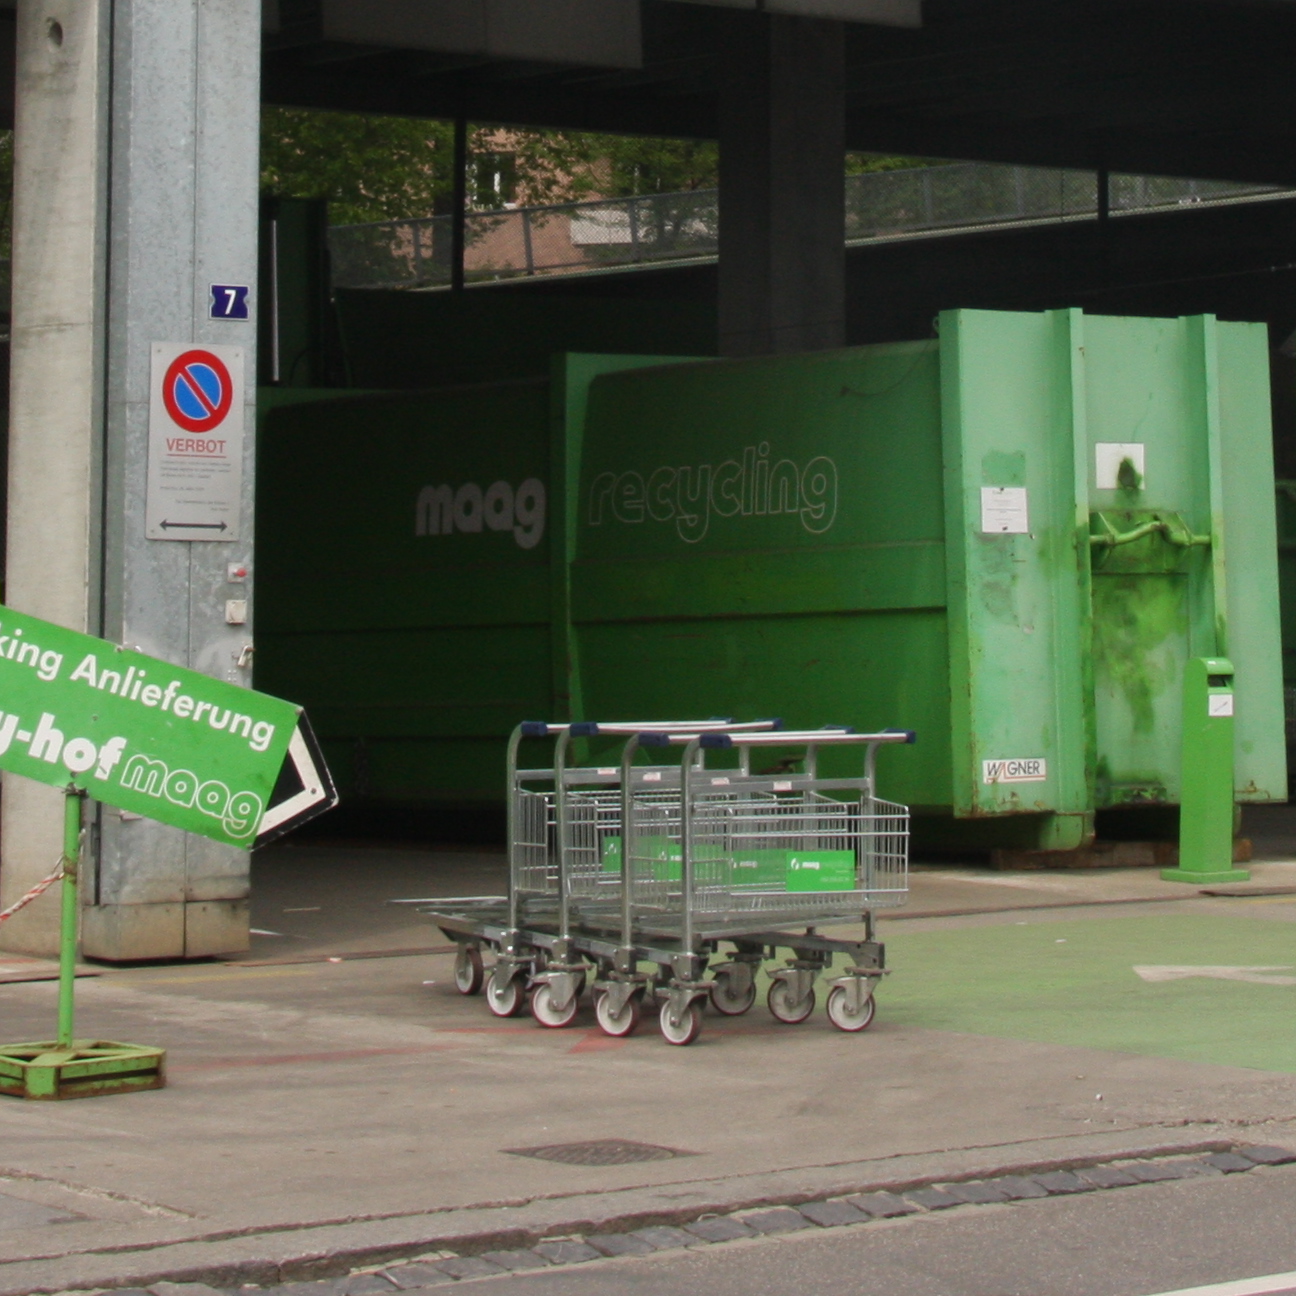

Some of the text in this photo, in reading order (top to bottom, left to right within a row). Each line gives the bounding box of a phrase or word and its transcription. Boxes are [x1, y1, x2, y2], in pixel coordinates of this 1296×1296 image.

[223, 289, 236, 315] 7
[166, 438, 227, 454] VERBOT
[415, 477, 546, 549] maag
[589, 441, 838, 543] recycling
[69, 654, 276, 752] Anlieferung
[120, 753, 263, 840] maag
